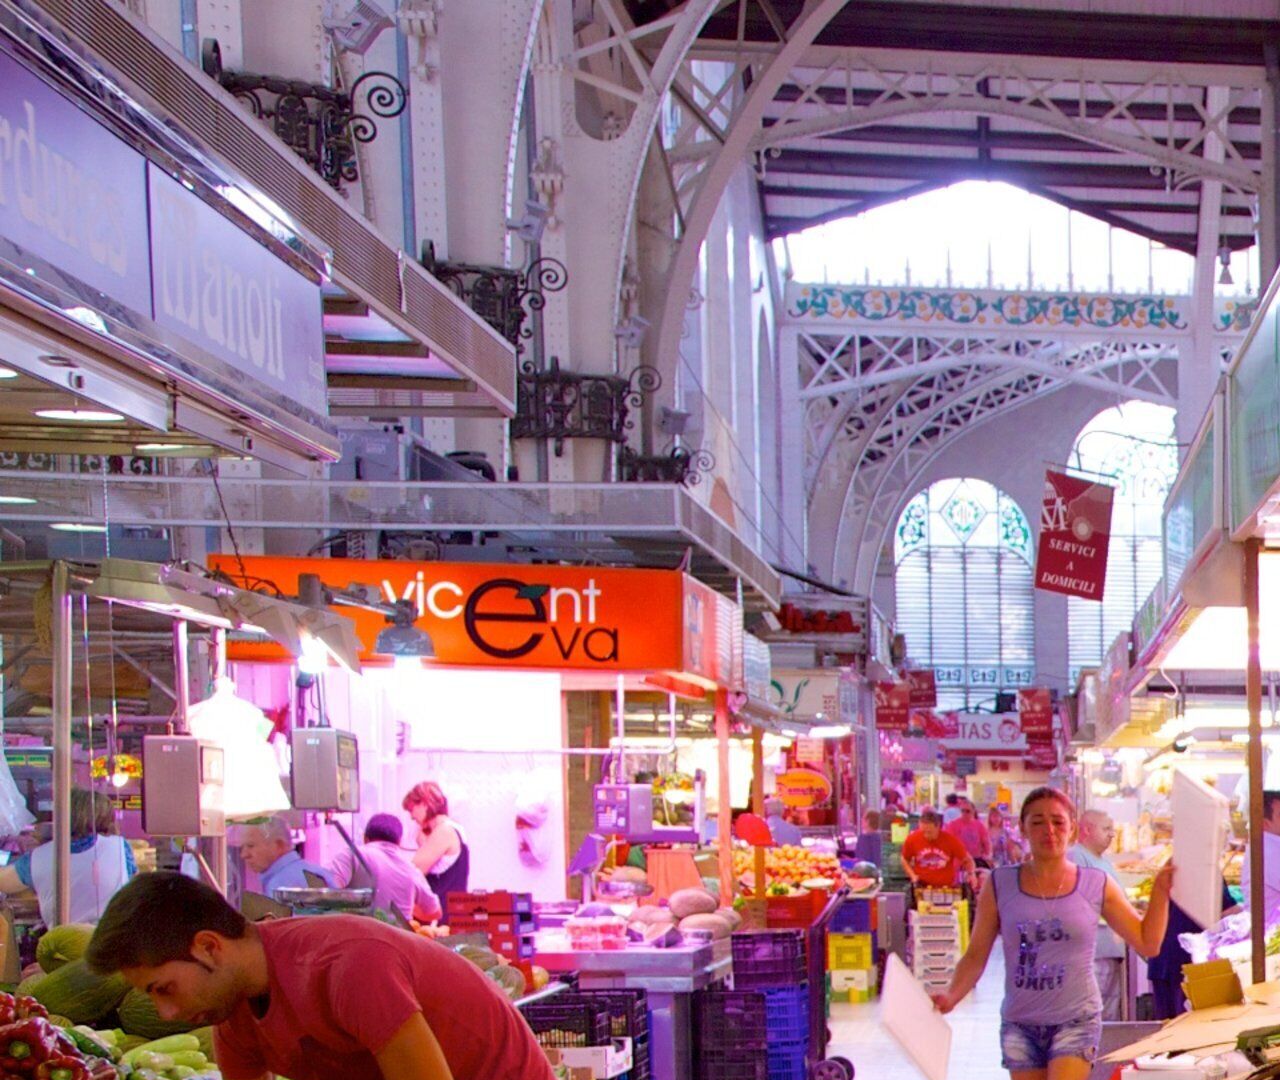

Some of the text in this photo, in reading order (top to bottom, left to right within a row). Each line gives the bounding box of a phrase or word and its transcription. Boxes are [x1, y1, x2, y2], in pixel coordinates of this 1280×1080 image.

[1049, 539, 1096, 558] SERVICI
[1066, 561, 1074, 571] A
[1041, 572, 1096, 594] DOMICILI
